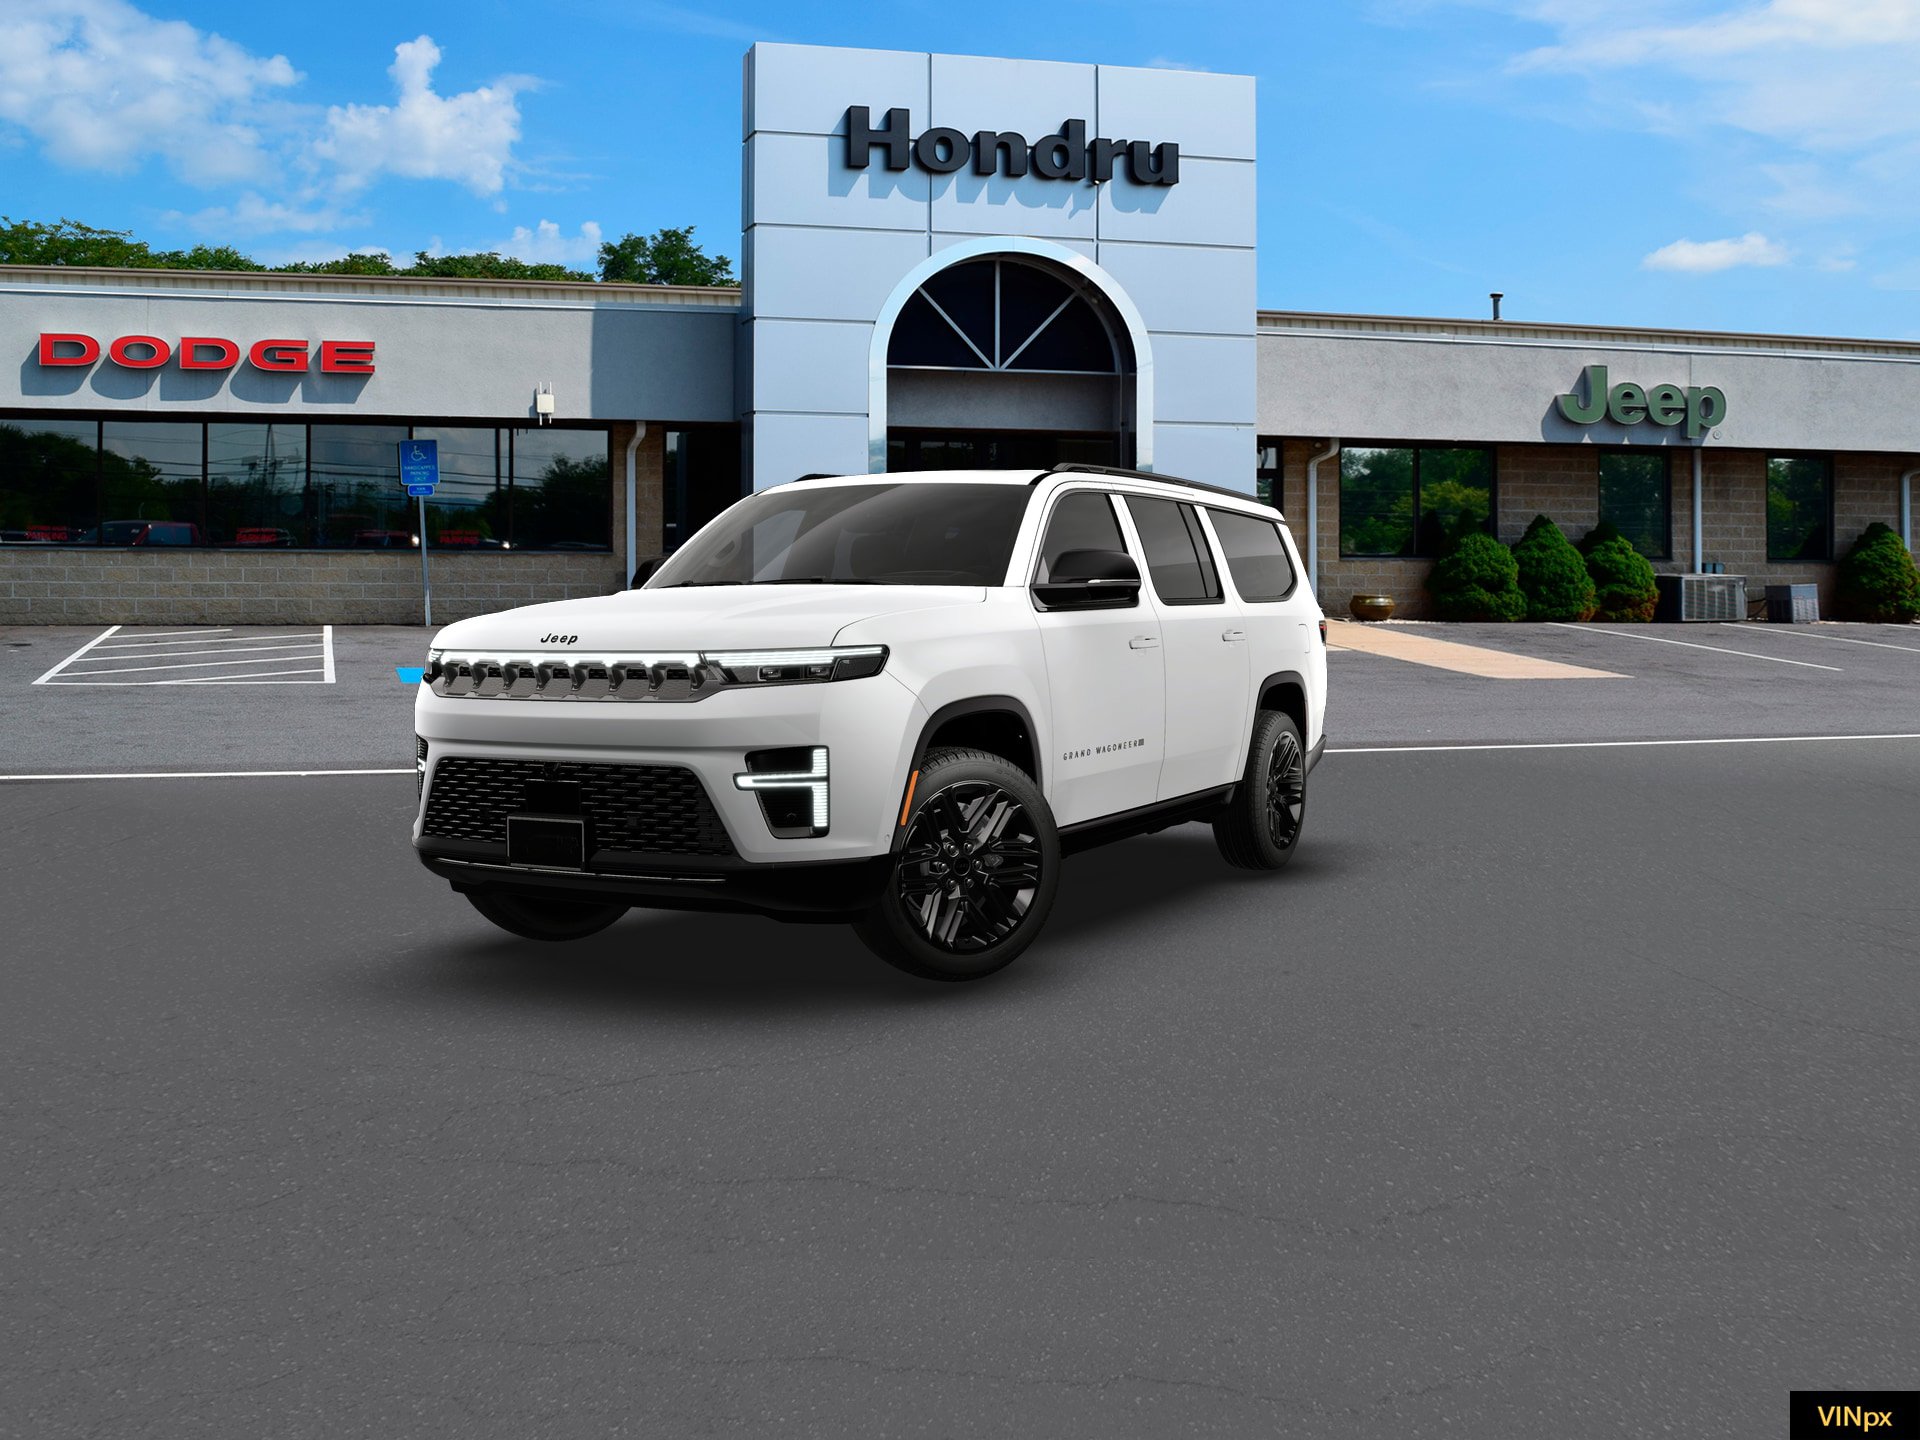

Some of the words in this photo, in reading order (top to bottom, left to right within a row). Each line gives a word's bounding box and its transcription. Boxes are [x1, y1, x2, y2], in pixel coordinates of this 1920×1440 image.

[845, 105, 1179, 186] Hondru
[39, 332, 375, 374] DODGE
[1556, 365, 1727, 439] Jeep
[540, 633, 578, 645] Jeep
[1063, 749, 1091, 760] GRAND
[1096, 740, 1138, 754] WAGONEER
